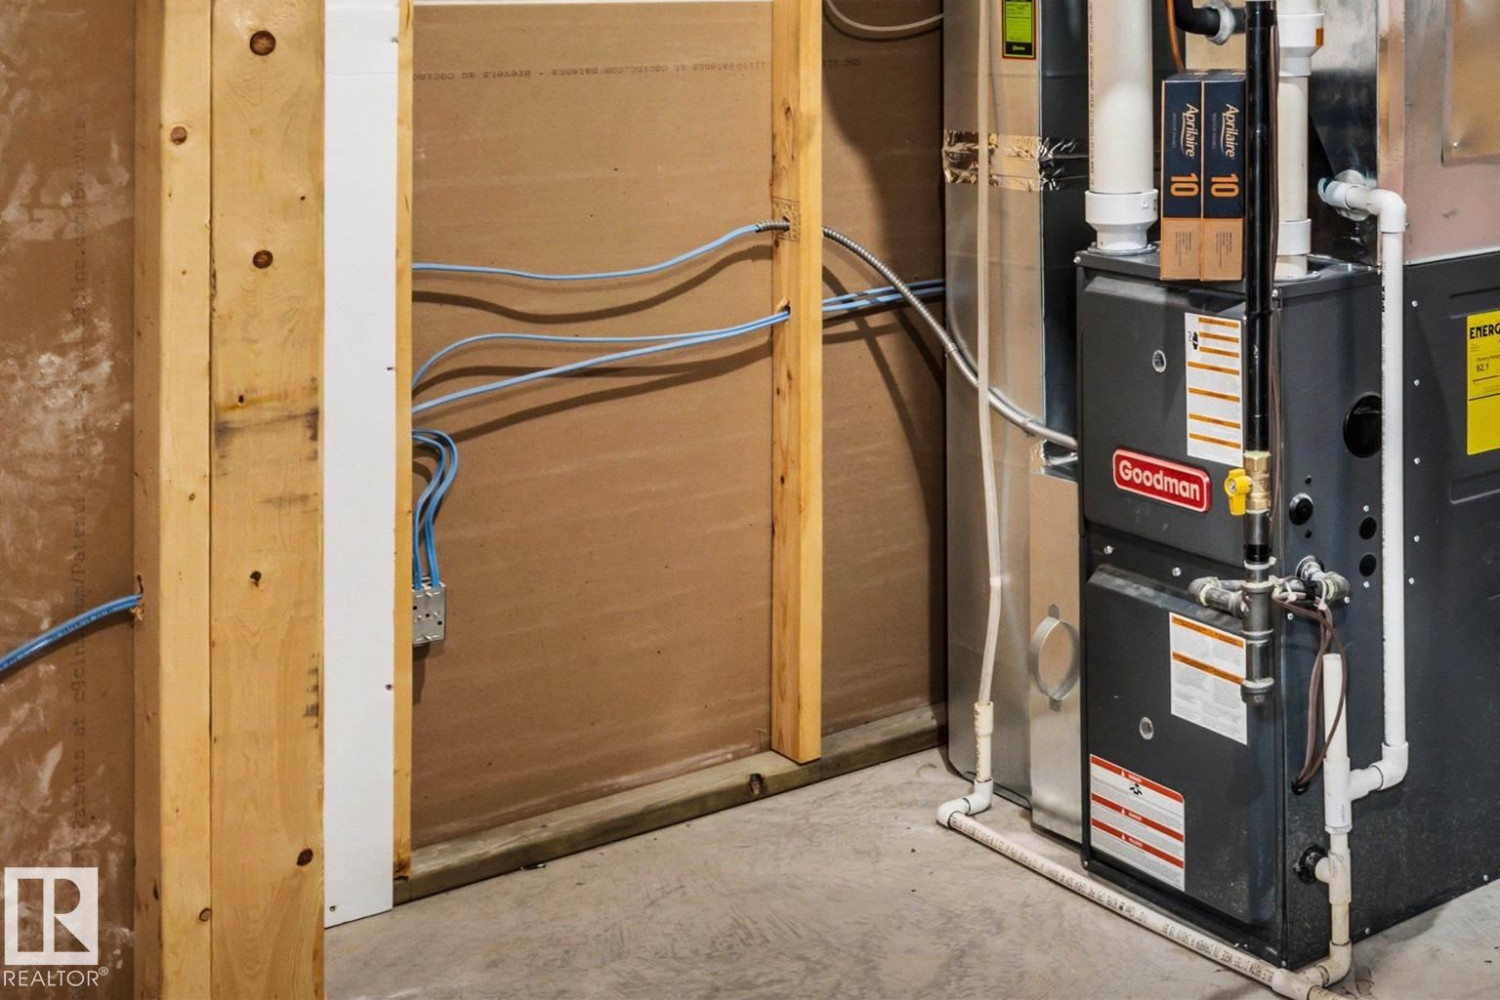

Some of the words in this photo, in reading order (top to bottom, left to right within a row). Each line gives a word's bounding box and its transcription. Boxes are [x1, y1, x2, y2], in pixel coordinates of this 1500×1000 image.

[1181, 104, 1200, 158] Aprilaire
[1221, 104, 1240, 158] Aprilaire
[1170, 173, 1199, 198] 10
[1210, 173, 1240, 198] 10
[1119, 459, 1200, 502] Goodman
